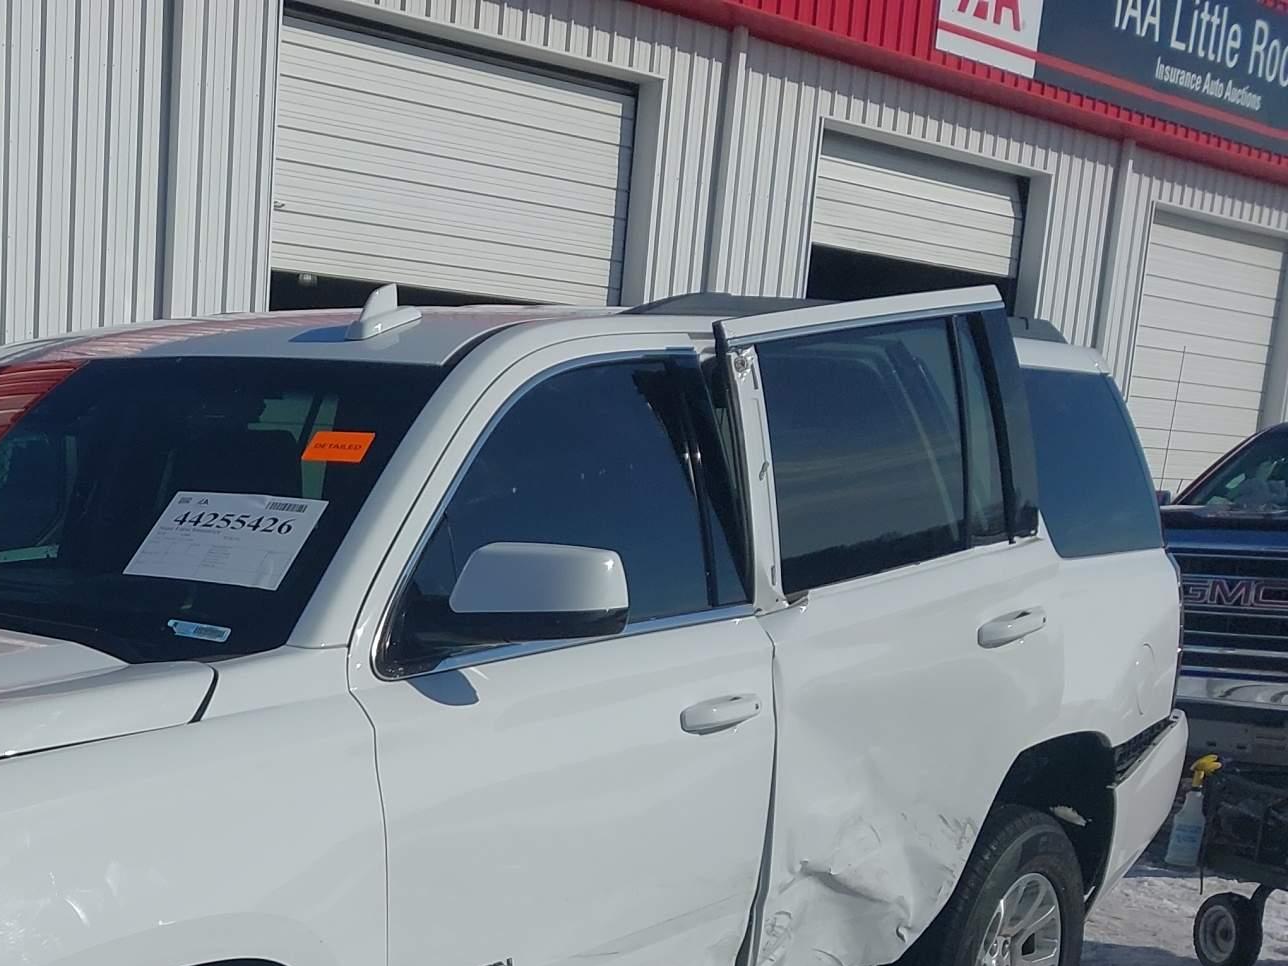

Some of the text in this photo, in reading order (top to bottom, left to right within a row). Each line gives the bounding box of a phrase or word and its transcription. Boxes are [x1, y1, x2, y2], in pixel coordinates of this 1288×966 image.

[1170, 0, 1242, 68] Little
[1155, 56, 1262, 111] Insurance Auto Auctions
[173, 511, 297, 535] 44255426
